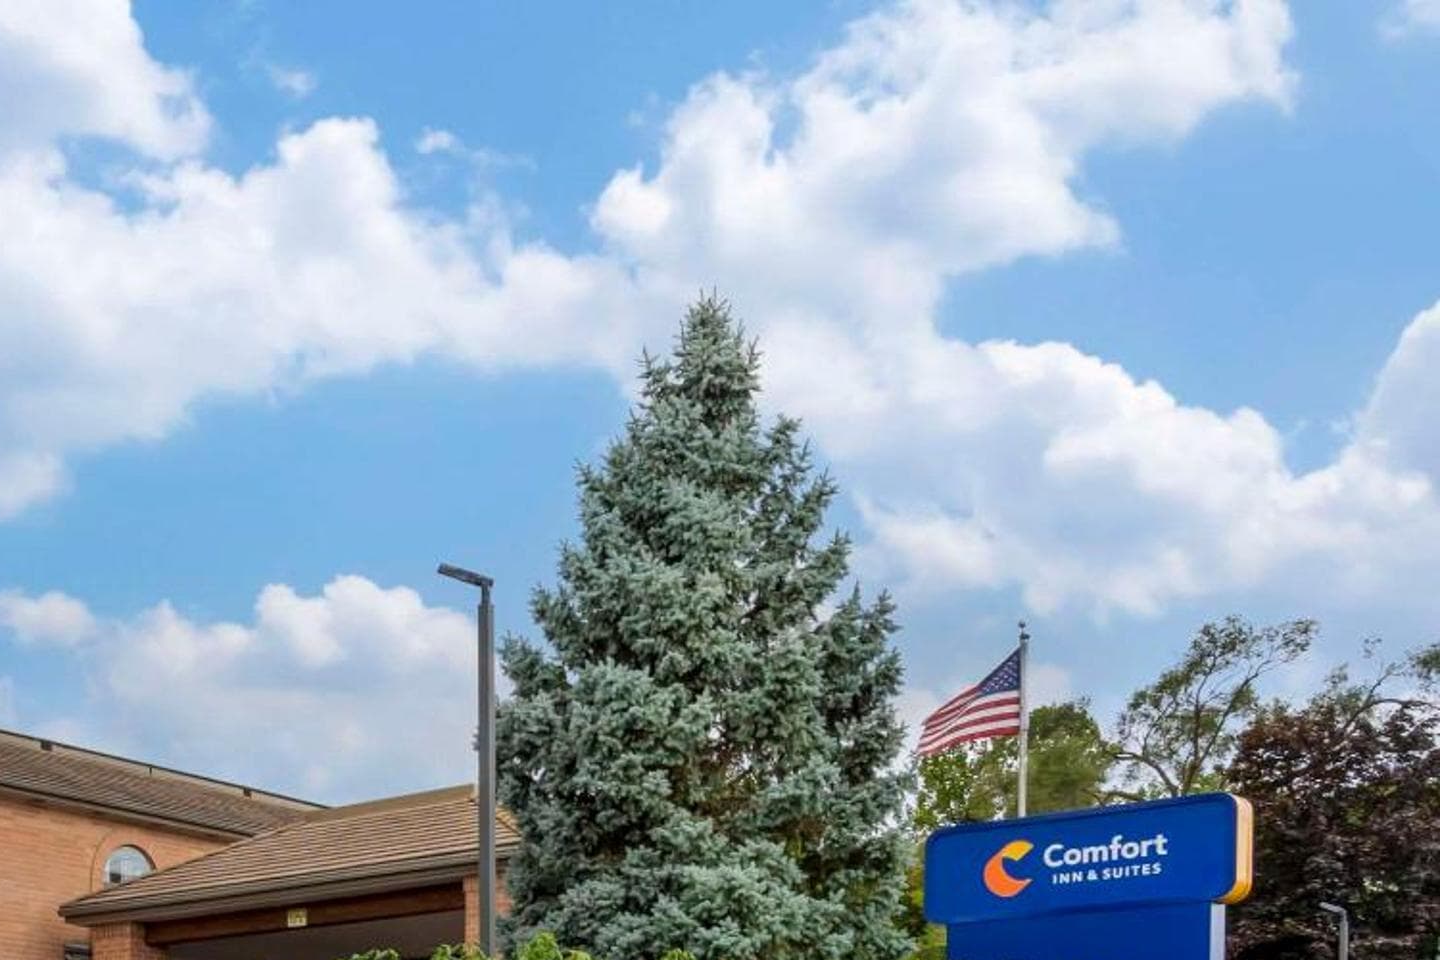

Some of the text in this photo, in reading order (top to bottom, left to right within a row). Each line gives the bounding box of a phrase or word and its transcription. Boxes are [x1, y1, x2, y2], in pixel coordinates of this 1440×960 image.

[1043, 834, 1168, 868] Comfort
[1052, 862, 1162, 885] INN & SUITES
